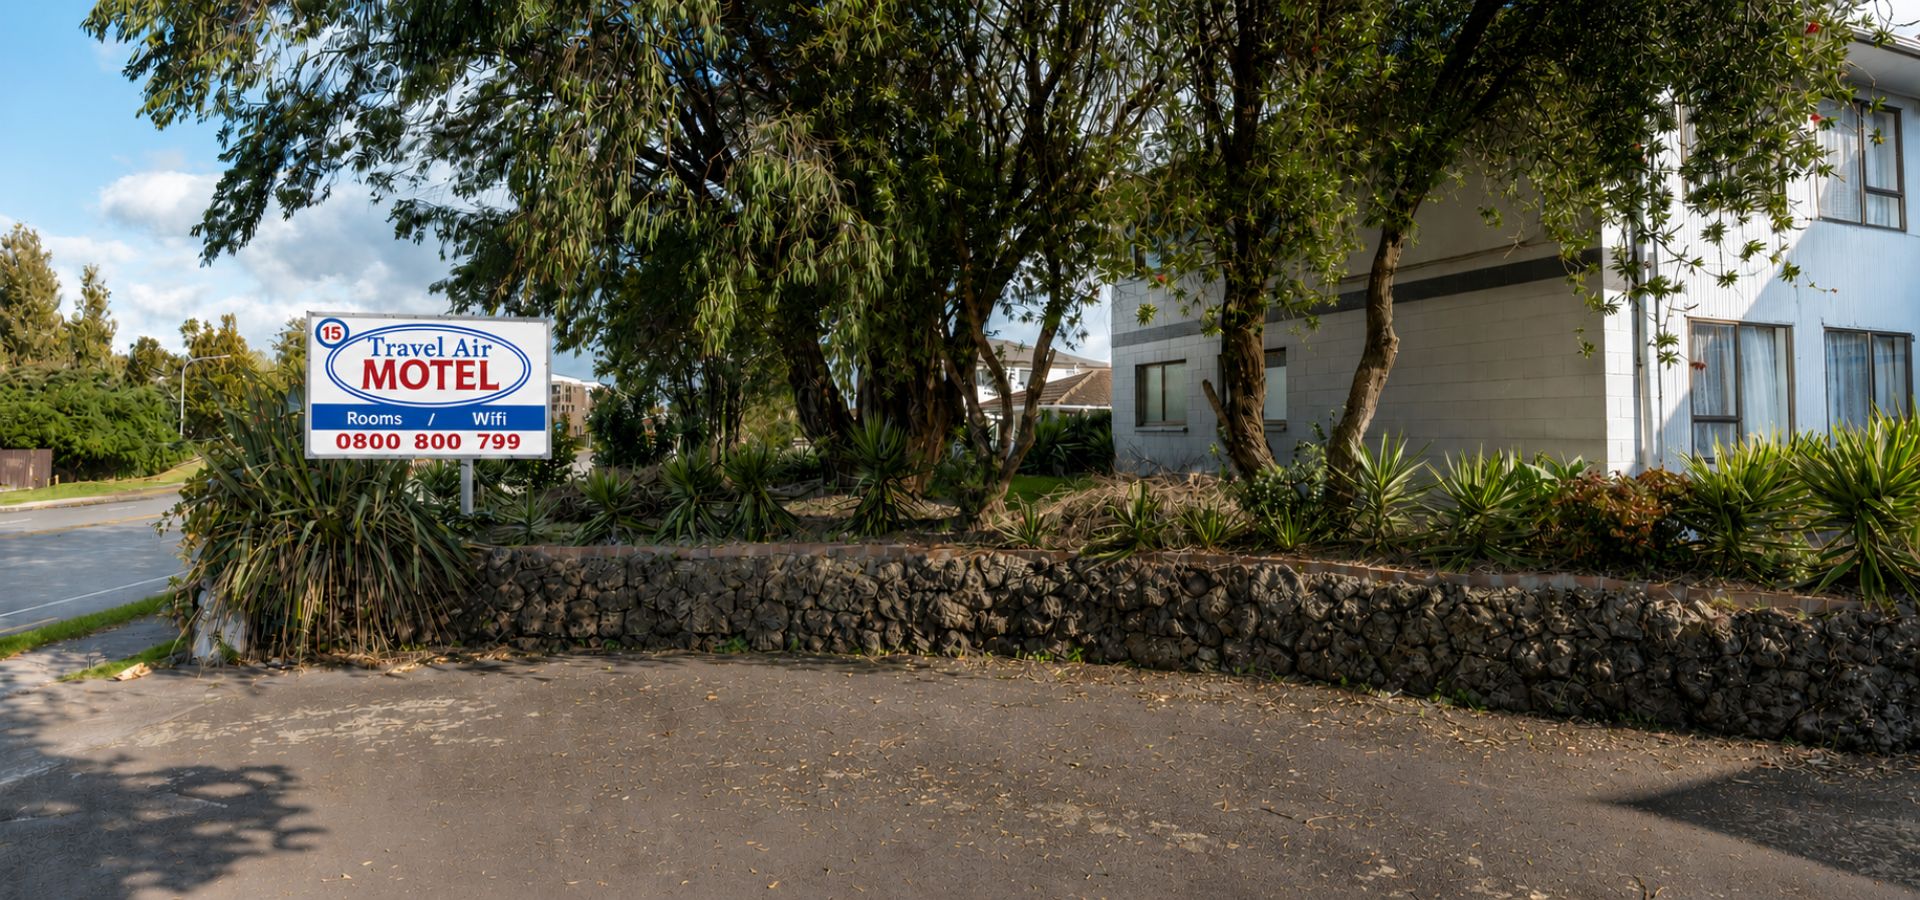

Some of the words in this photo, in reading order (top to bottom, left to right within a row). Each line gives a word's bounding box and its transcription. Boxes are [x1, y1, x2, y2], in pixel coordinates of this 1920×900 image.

[323, 326, 341, 340] 15
[367, 336, 443, 358] Travel
[452, 337, 493, 358] Air
[361, 359, 500, 391] MOTEL
[347, 411, 403, 425] Rooms
[335, 433, 401, 450] 0800
[414, 433, 462, 450] 800
[477, 433, 521, 450] 799
